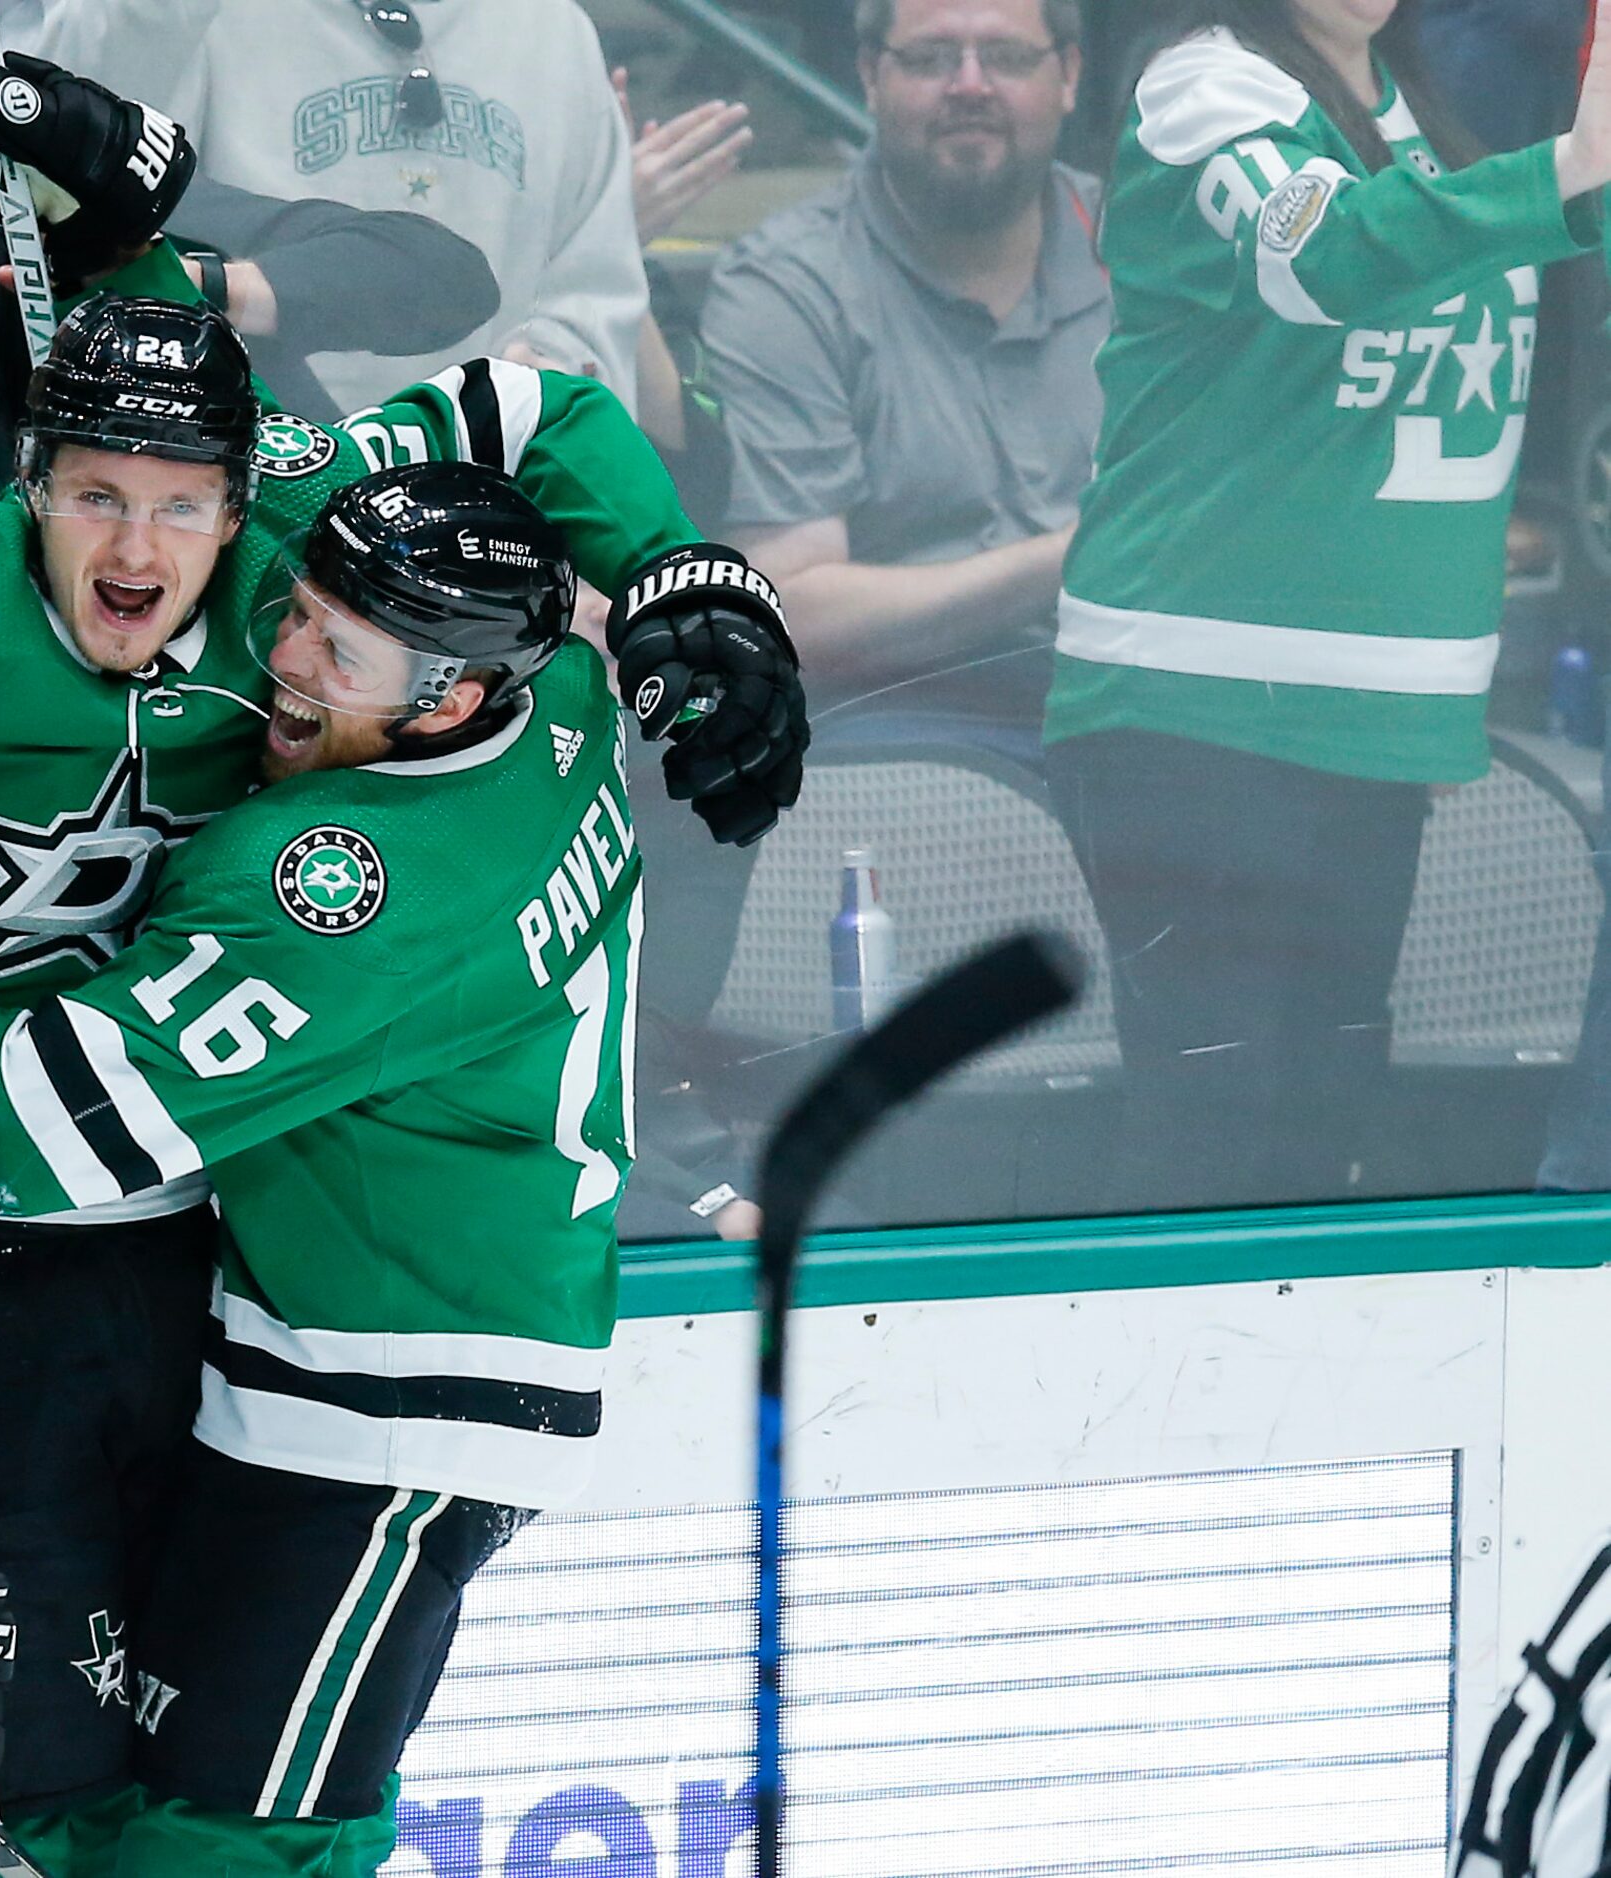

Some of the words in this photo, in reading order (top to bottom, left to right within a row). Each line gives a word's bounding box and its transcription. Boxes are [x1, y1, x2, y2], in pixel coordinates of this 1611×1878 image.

[135, 334, 190, 370] 24
[114, 393, 198, 418] CCM
[369, 485, 417, 520] 16
[329, 514, 372, 554] WARRIOR
[488, 538, 532, 555] ENERGY
[488, 550, 539, 569] TRANSFER
[558, 729, 585, 777] adidas
[292, 833, 370, 893] DALLAS
[282, 877, 359, 927] STARS
[130, 933, 311, 1079] 16
